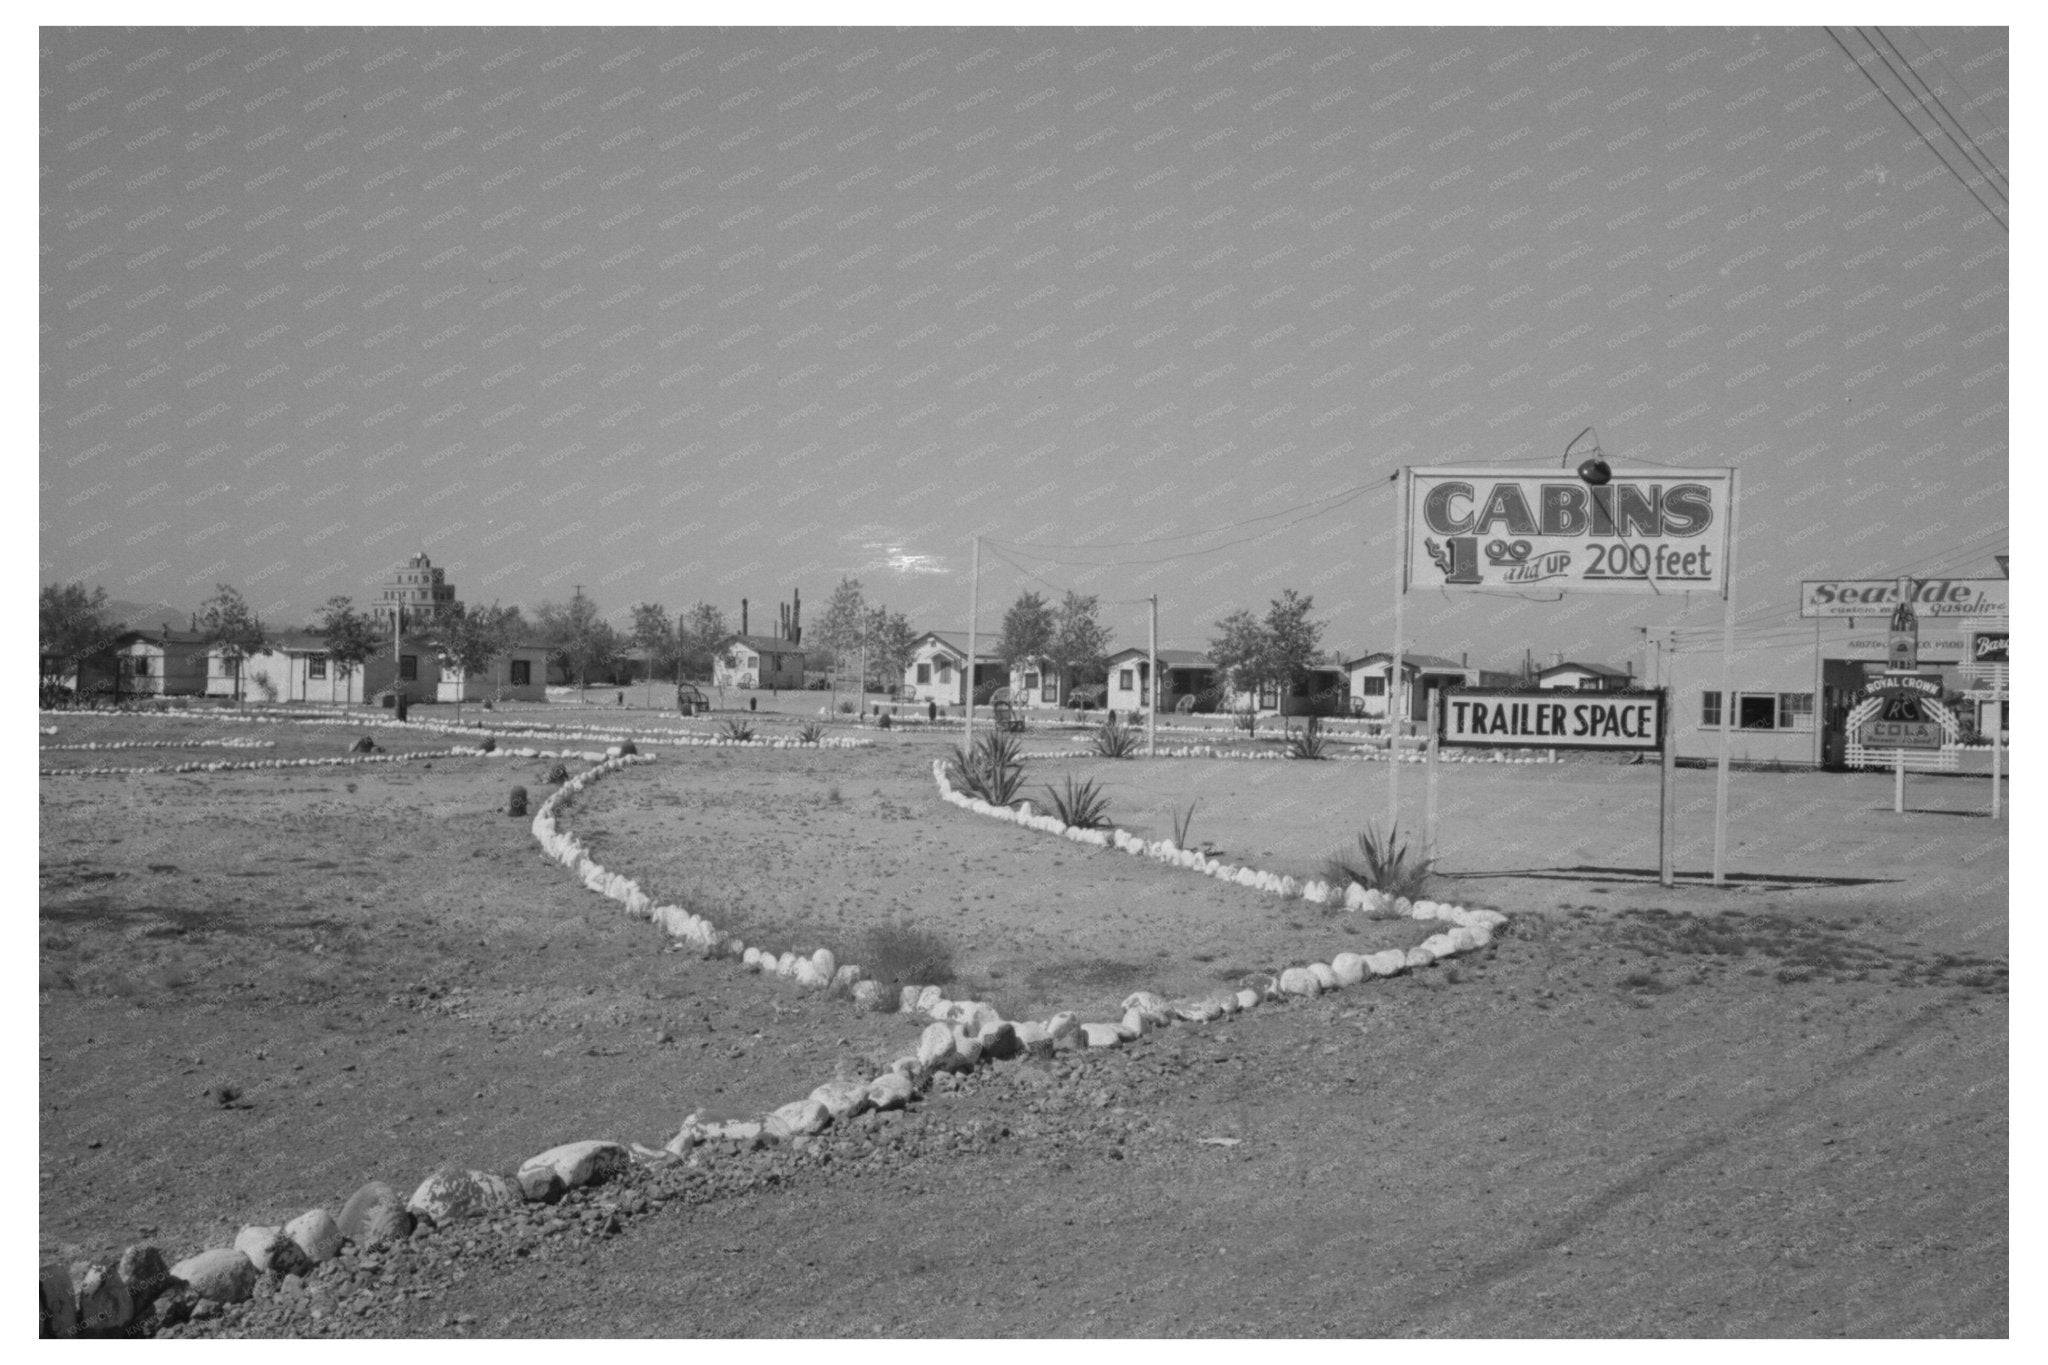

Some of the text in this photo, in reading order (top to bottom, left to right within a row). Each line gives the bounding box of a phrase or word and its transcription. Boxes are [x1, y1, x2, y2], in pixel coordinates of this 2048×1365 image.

[1424, 481, 1713, 538] CABINS
[1547, 555, 1571, 574] UP
[1584, 543, 1651, 575] 200
[1655, 544, 1712, 575] feet
[1866, 677, 1939, 694] ROYAL CROWN
[1452, 701, 1652, 738] TRAILER SPACE
[1888, 701, 1915, 719] RC
